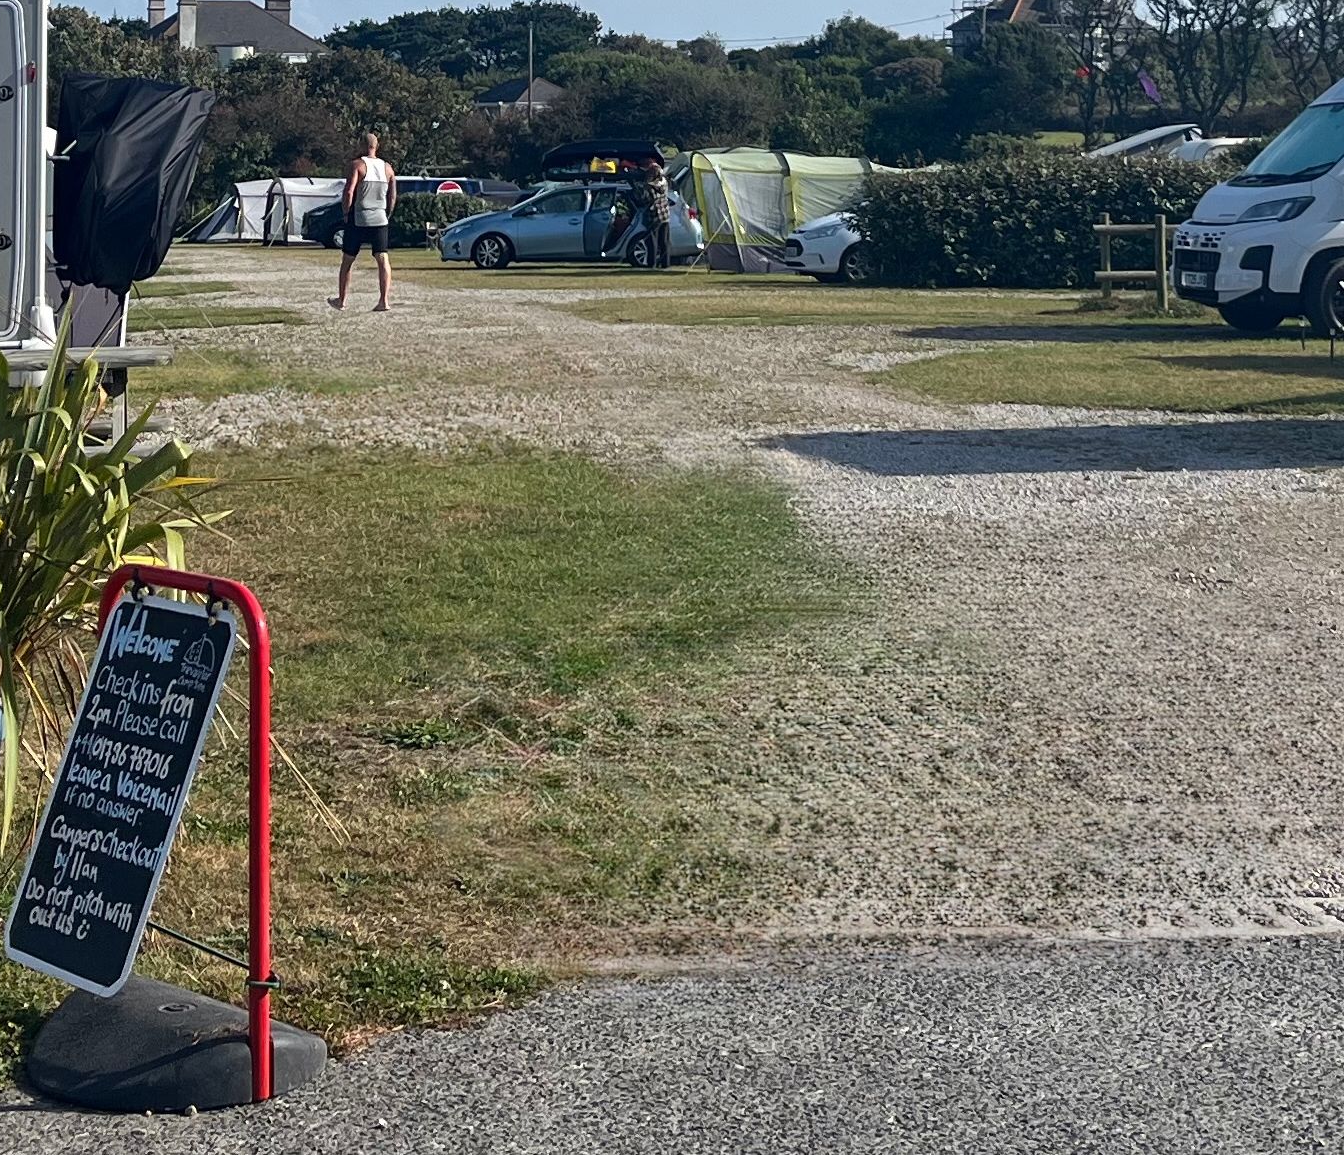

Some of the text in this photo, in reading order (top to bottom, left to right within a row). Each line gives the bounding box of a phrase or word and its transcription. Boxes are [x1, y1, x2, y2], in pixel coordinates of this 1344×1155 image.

[111, 698, 159, 737] Please
[129, 744, 174, 780] 787016
[77, 792, 95, 809] no
[99, 773, 113, 793] a
[53, 844, 69, 886] by
[25, 877, 45, 901] Do
[45, 885, 73, 912] not
[72, 889, 104, 920] pitch
[29, 905, 75, 936] out us
